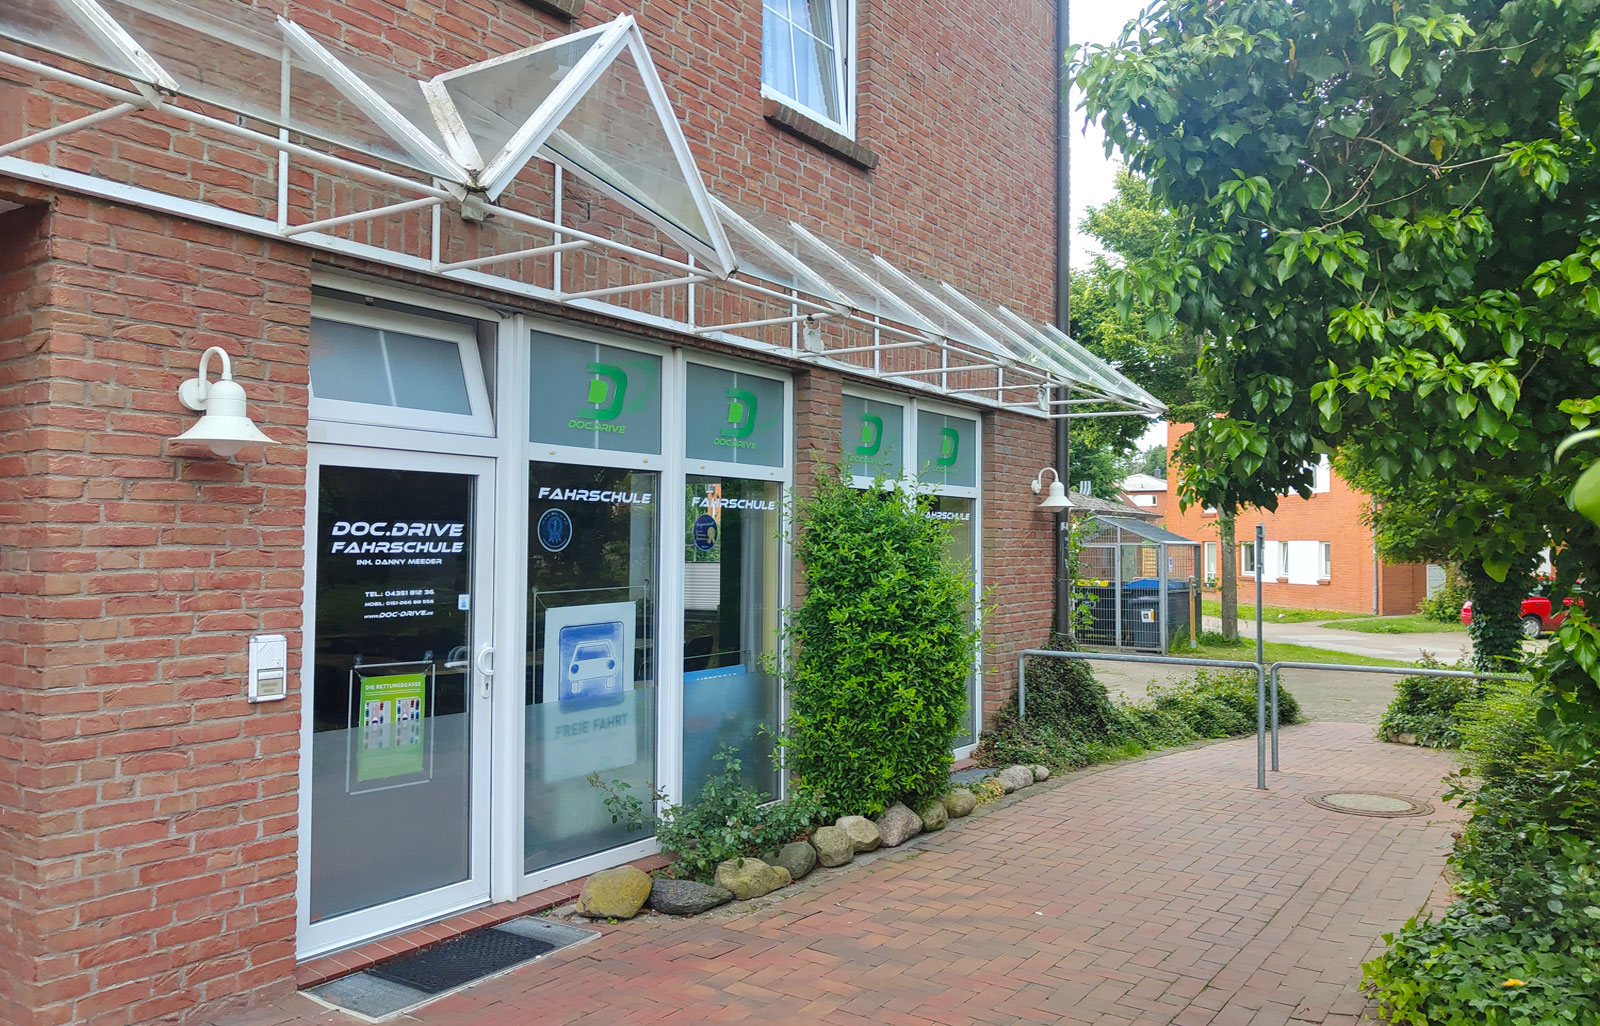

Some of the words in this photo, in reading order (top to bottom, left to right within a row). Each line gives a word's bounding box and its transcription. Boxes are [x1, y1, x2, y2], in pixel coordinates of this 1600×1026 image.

[567, 419, 627, 434] DOC.DRIVE
[538, 487, 652, 505] FAHRSCHULE
[691, 496, 776, 511] FAHRSCHULE
[924, 511, 970, 520] AHRSCHULE
[331, 521, 465, 537] DOC.DRIVE
[331, 541, 464, 554] FAHRSCHULE
[356, 558, 373, 566] INH.
[375, 558, 406, 566] DANNY
[555, 721, 590, 738] FREIE
[592, 713, 628, 732] FAHRT
